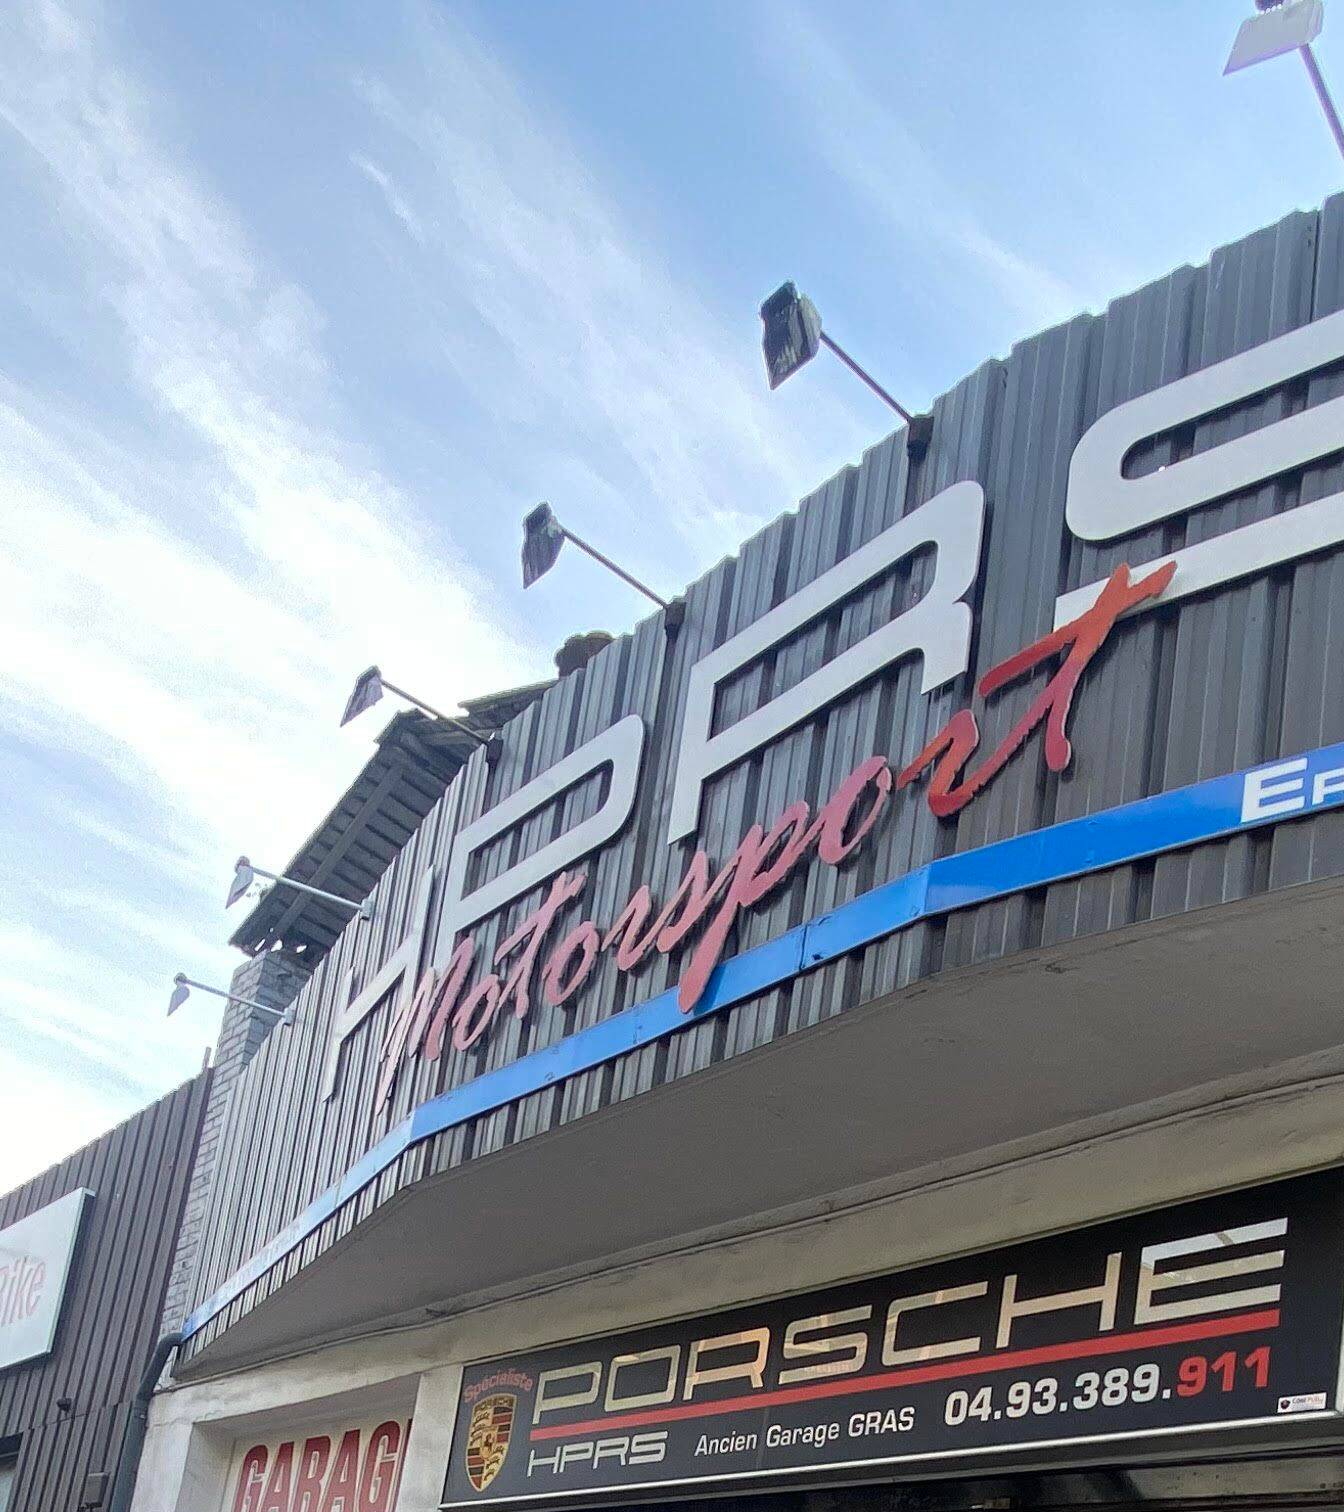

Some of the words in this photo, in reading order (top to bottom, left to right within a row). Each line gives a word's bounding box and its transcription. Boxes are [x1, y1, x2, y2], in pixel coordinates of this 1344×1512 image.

[375, 558, 1179, 1116] Motorsport
[531, 1215, 1290, 1425] PORSCHE
[944, 1345, 1271, 1428] 04.93.389.911
[526, 1430, 669, 1478] HPRS
[695, 1431, 758, 1458] Ancien
[765, 1420, 840, 1450] Garage
[847, 1406, 916, 1438] GRAS
